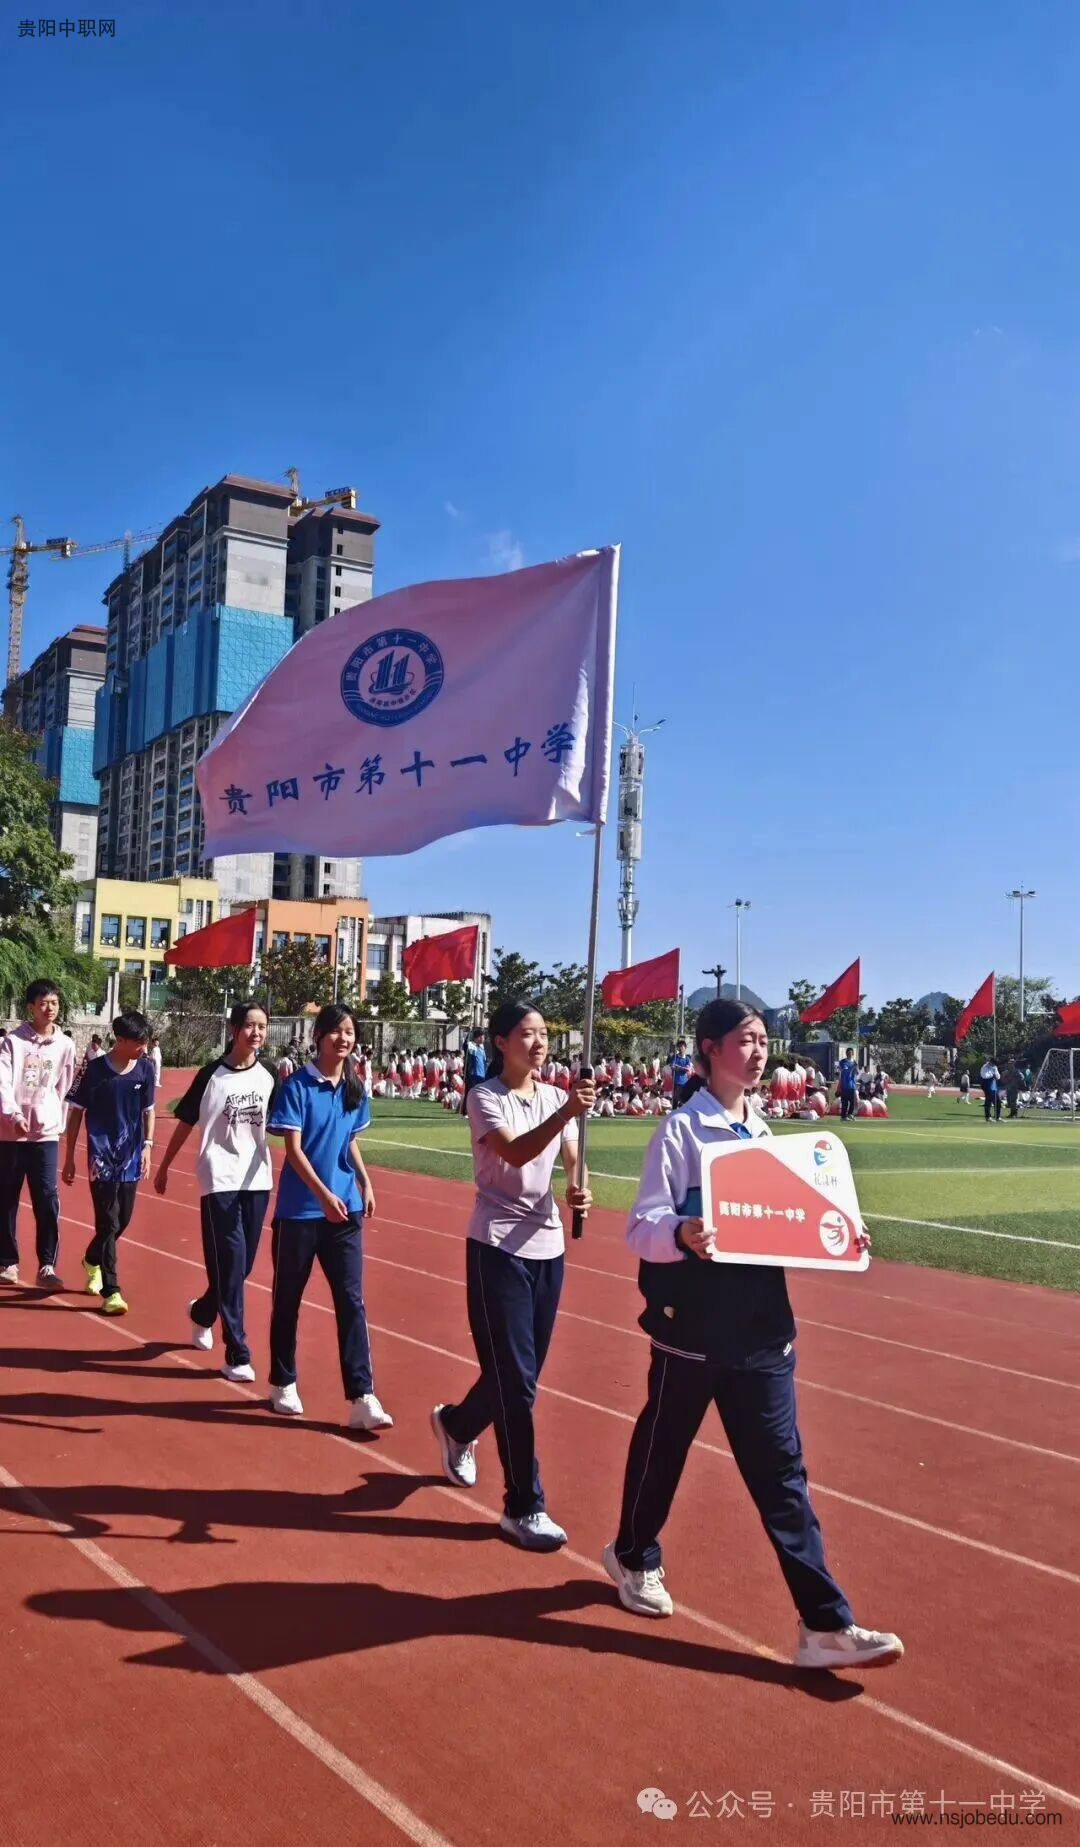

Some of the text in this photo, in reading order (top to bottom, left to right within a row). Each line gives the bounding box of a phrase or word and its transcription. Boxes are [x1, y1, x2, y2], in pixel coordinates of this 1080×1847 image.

[219, 721, 579, 816] 贵阳市第十一中学
